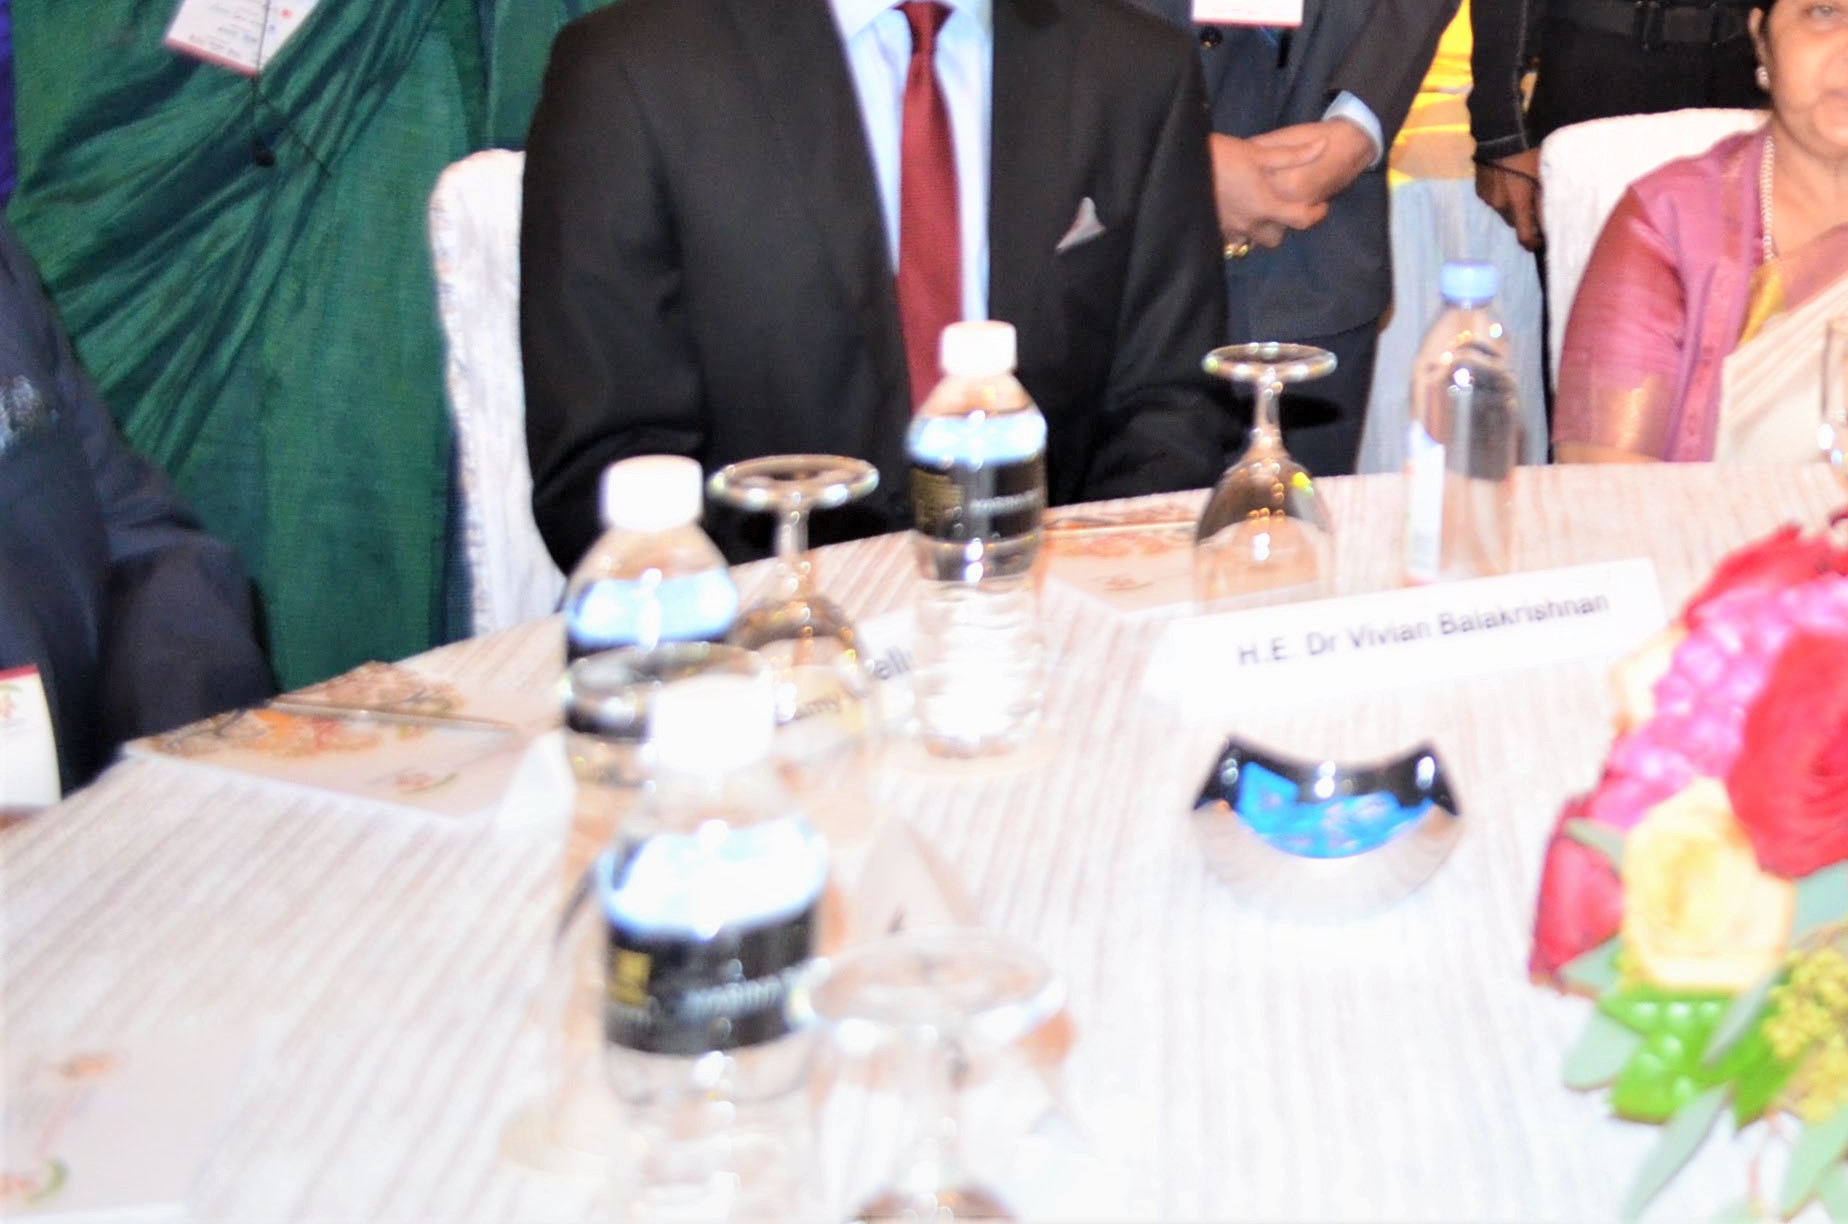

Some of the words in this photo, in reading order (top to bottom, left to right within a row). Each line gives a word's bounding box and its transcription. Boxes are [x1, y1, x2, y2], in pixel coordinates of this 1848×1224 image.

[1306, 629, 1341, 657] Dr
[1350, 619, 1433, 650] Vivian
[1438, 593, 1609, 636] Balakrishnan
